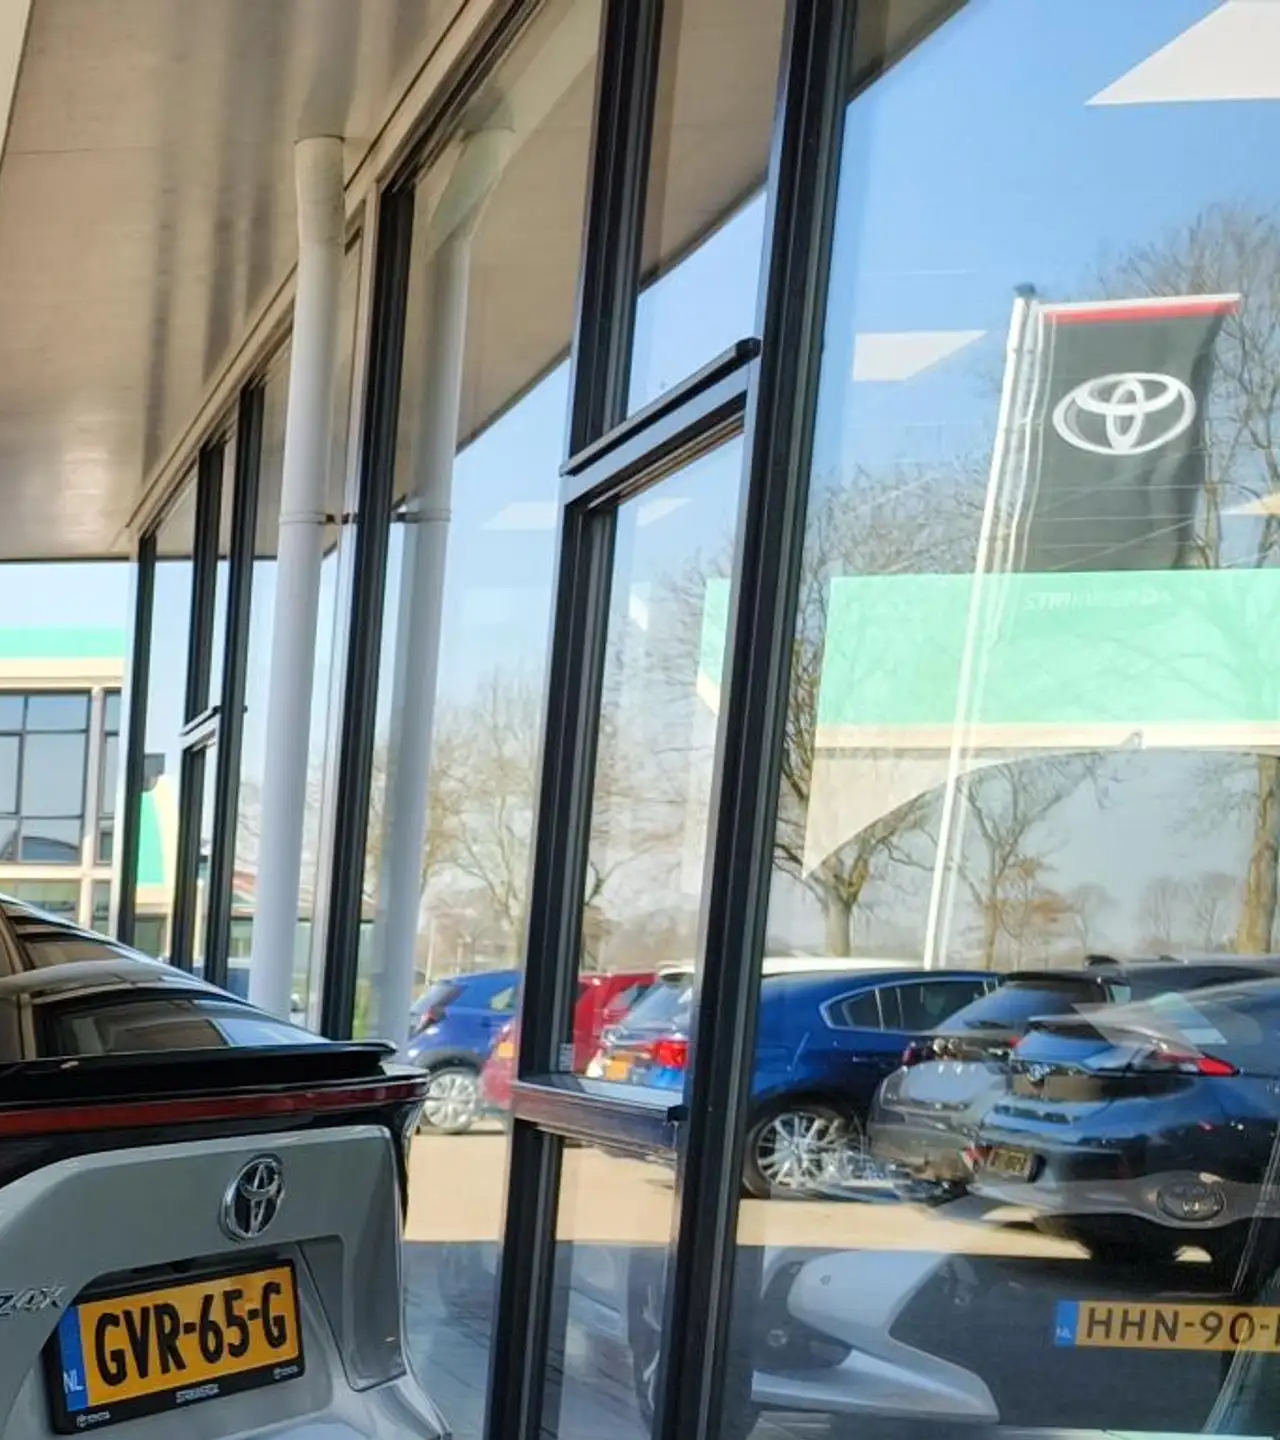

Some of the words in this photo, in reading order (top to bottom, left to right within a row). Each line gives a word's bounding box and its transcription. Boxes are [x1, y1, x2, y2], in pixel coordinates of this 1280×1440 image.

[94, 1281, 287, 1387] GVR-65-G
[1086, 1307, 1280, 1345] HHN-90-
[63, 1370, 84, 1394] NL
